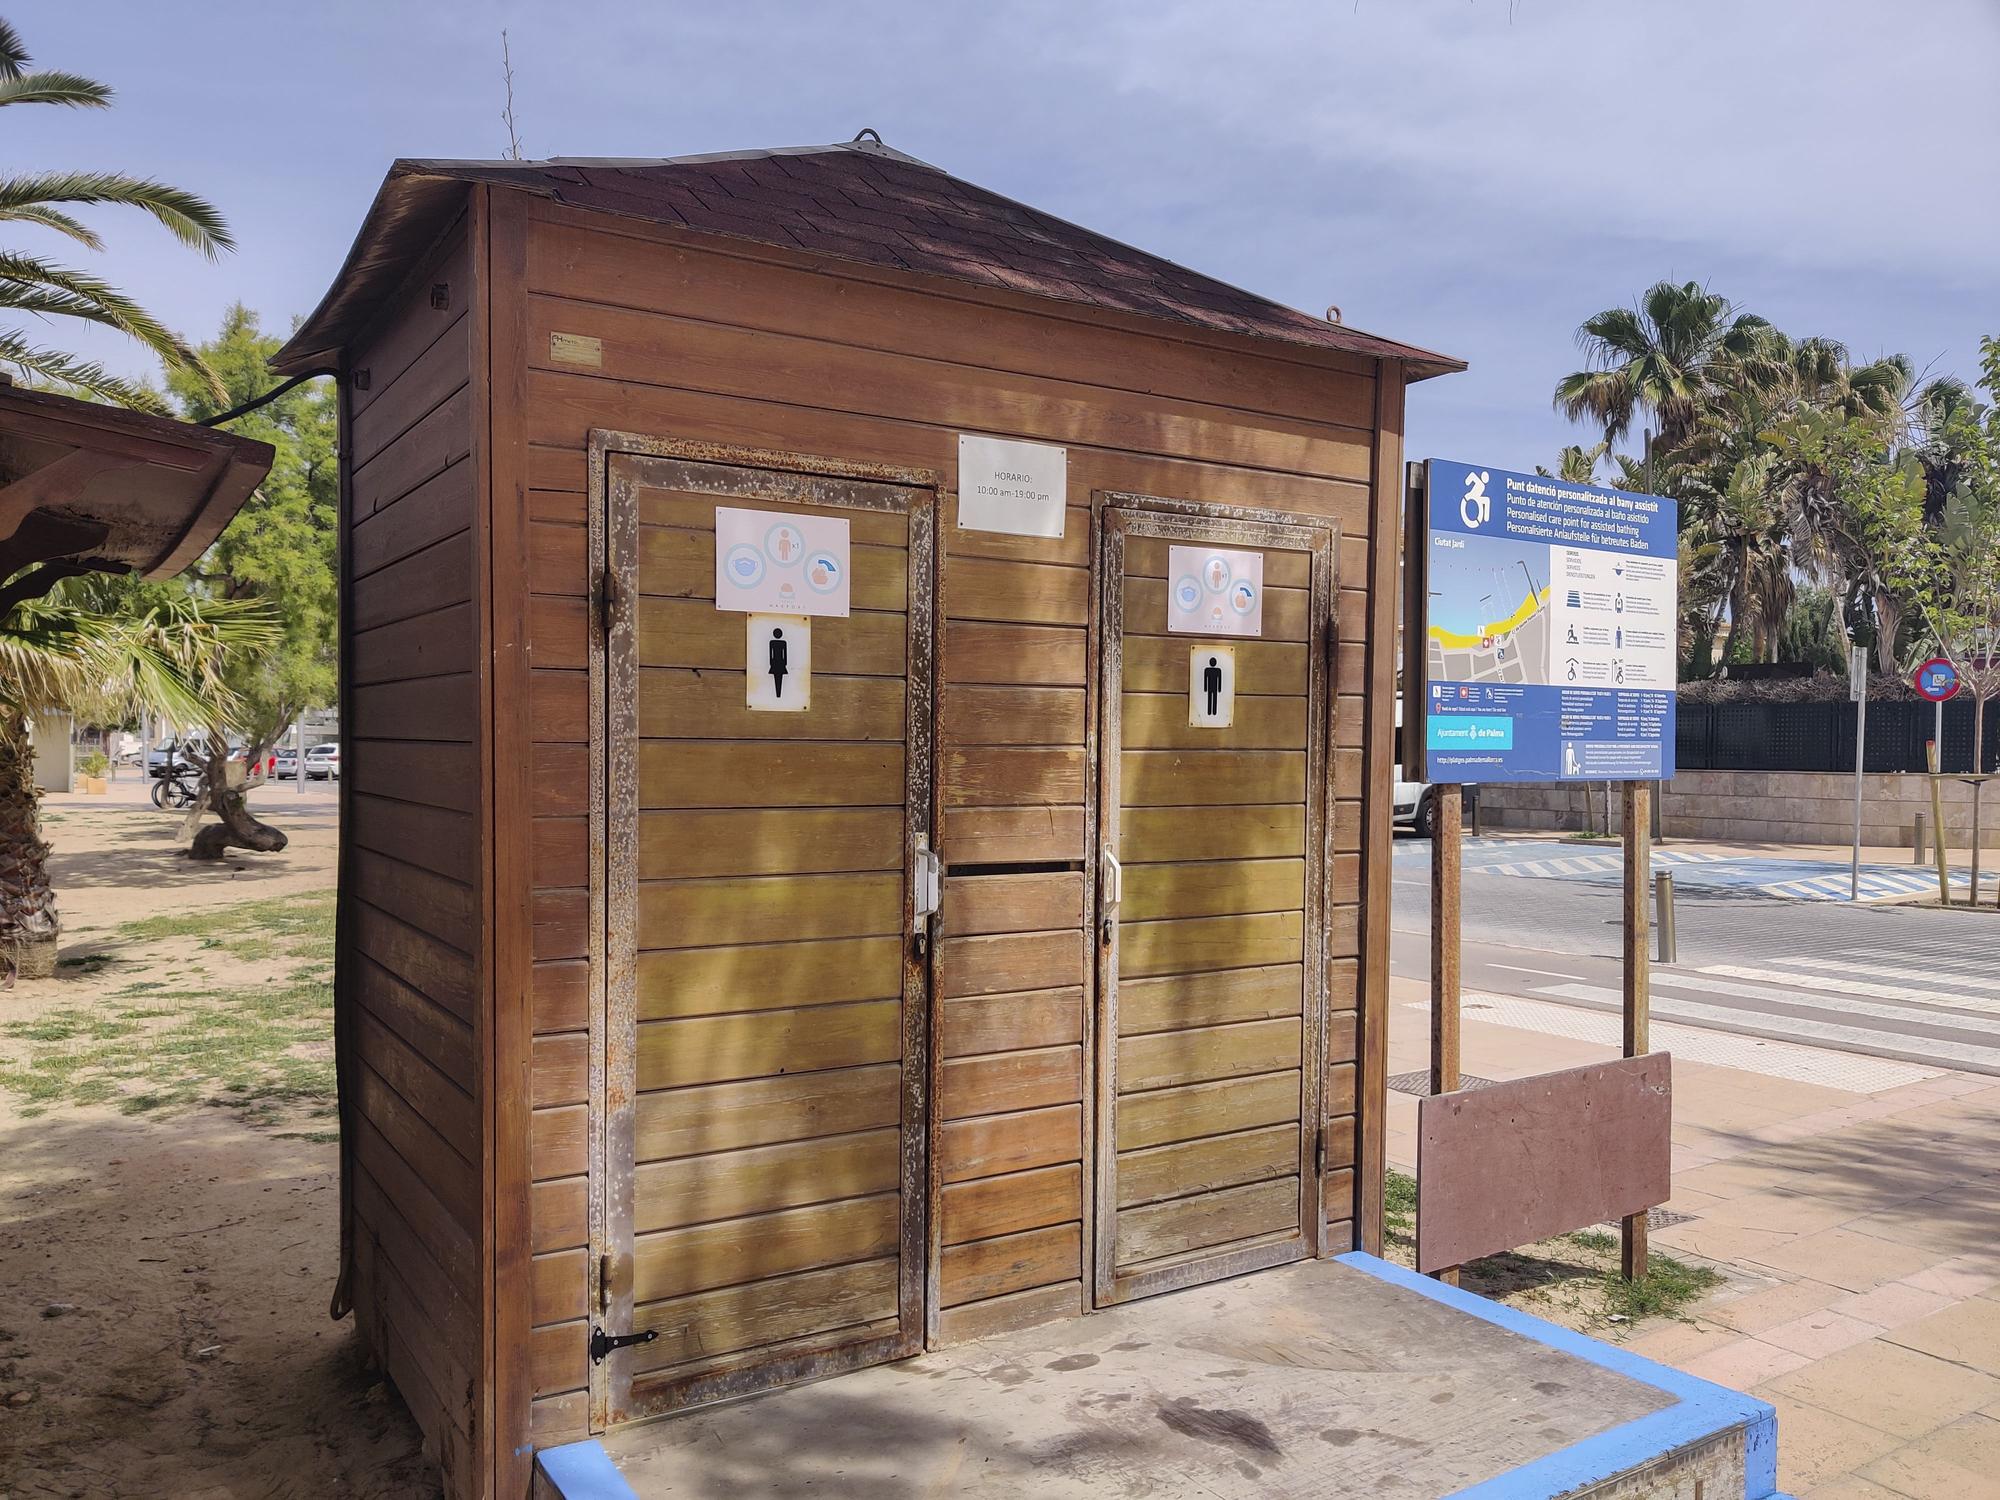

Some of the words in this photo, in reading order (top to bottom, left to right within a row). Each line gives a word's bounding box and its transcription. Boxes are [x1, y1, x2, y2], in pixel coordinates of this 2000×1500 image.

[977, 485, 998, 496] 10:00
[999, 489, 1035, 500] am-19:00
[1037, 493, 1050, 501] pm
[1506, 478, 1525, 491] Punt
[1557, 488, 1608, 505] personalitzada
[1609, 496, 1616, 506] al
[1616, 498, 1634, 512] bany
[1634, 500, 1659, 513] assistit
[1506, 493, 1526, 506] Punto
[1527, 496, 1536, 507] de
[1536, 498, 1563, 512] atención
[1563, 503, 1604, 518] personalizada
[1604, 508, 1611, 518] al
[1611, 509, 1626, 521] baño
[1626, 511, 1650, 524] asistido
[1506, 507, 1548, 523] Personalised
[1548, 514, 1562, 526] care
[1562, 516, 1580, 529] point
[1580, 518, 1590, 529] for
[1590, 520, 1616, 533] assisted
[1616, 523, 1640, 538] bathing
[1434, 537, 1451, 548] Ciutat
[1506, 521, 1553, 538] Personalisierte
[1553, 528, 1590, 543] Anlaufstelle
[1591, 533, 1600, 544] für
[1600, 535, 1629, 548] betreutes
[1630, 538, 1649, 550] Baden
[1437, 728, 1469, 738] Ajuntament
[1477, 729, 1486, 737] de
[1486, 729, 1504, 738] Palma
